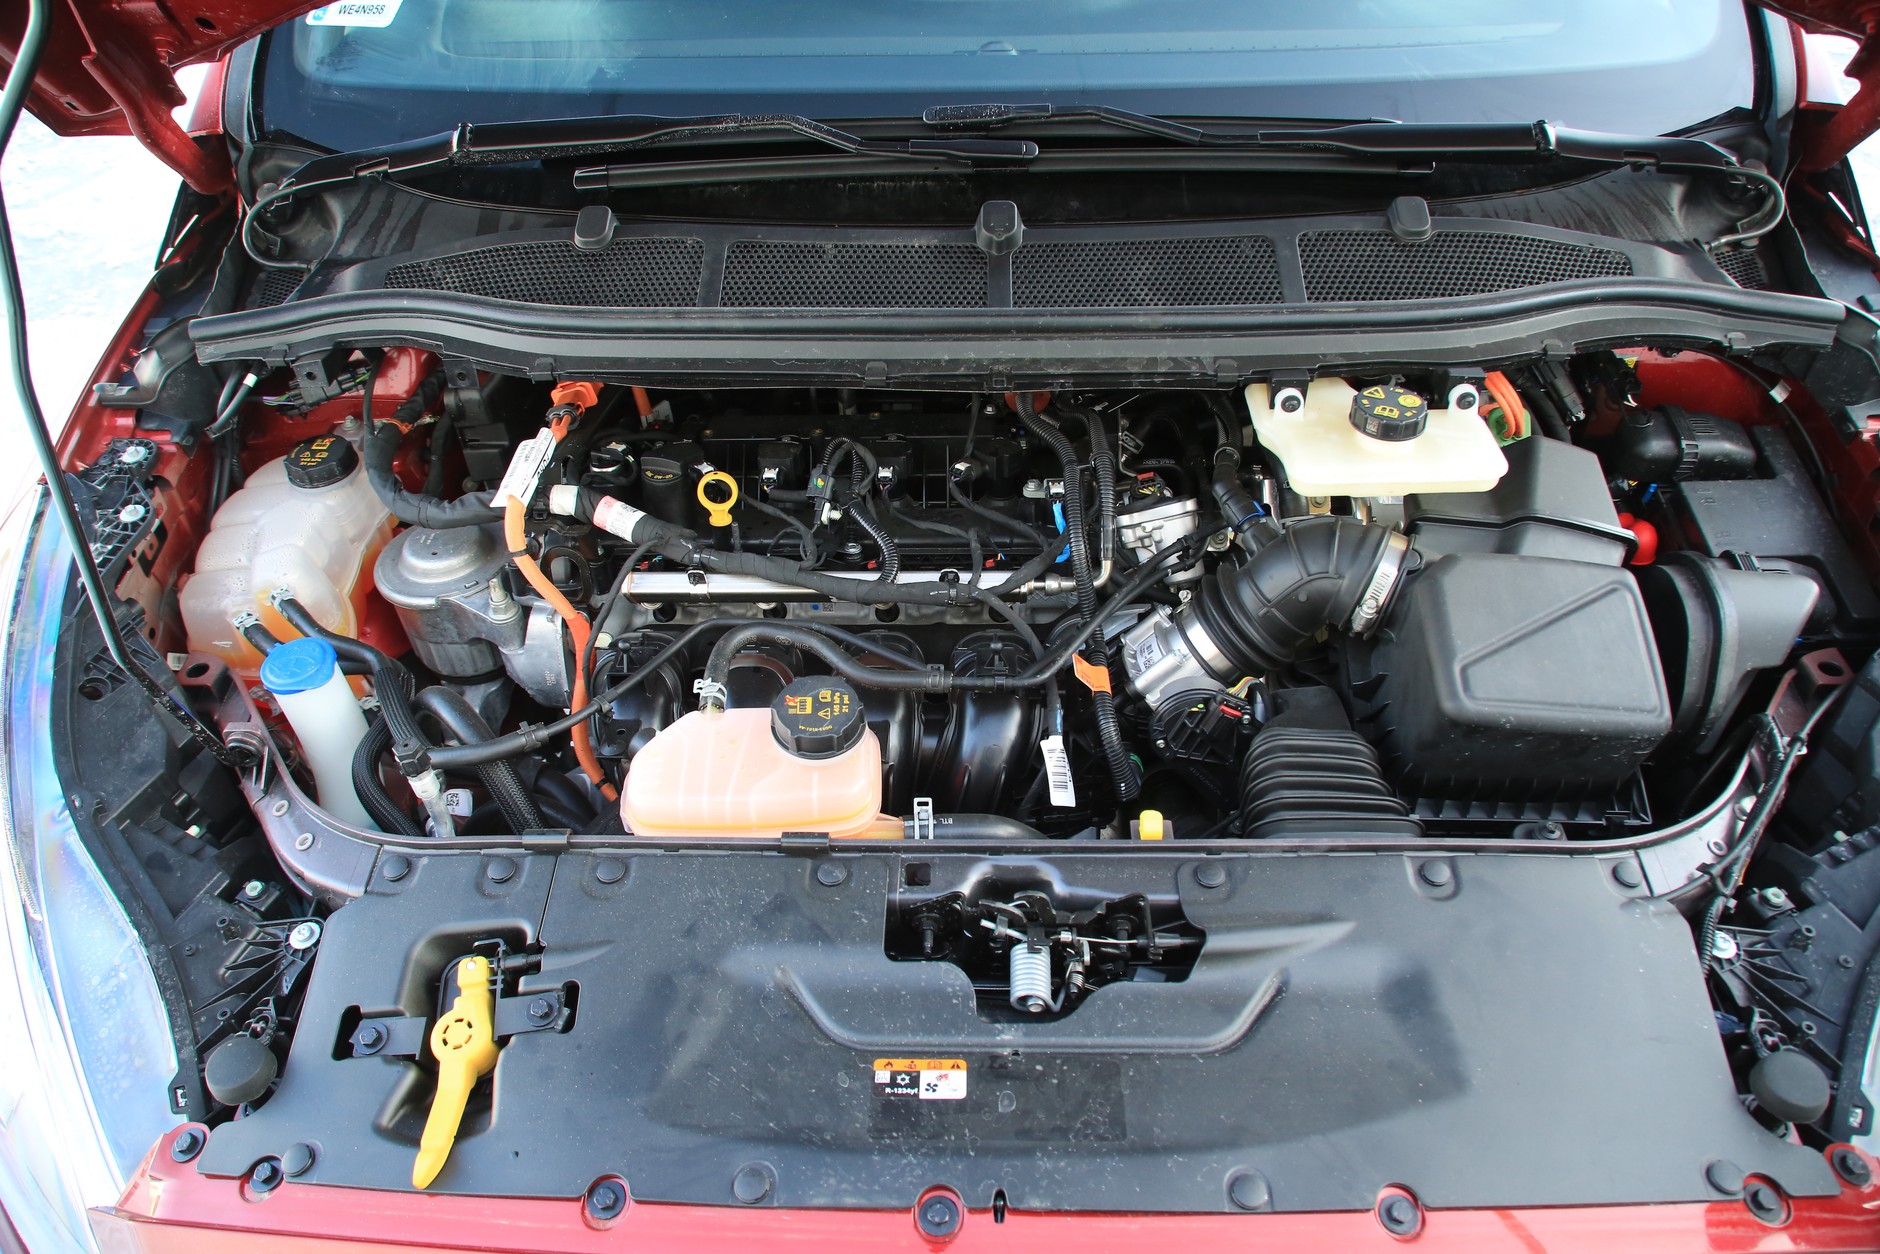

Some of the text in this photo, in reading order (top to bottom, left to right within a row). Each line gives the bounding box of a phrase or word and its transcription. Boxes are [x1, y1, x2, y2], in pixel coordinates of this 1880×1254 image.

[338, 4, 386, 15] WE4N958
[842, 694, 850, 704] psi
[833, 704, 841, 716] 145
[884, 1087, 918, 1096] R-1234yf
